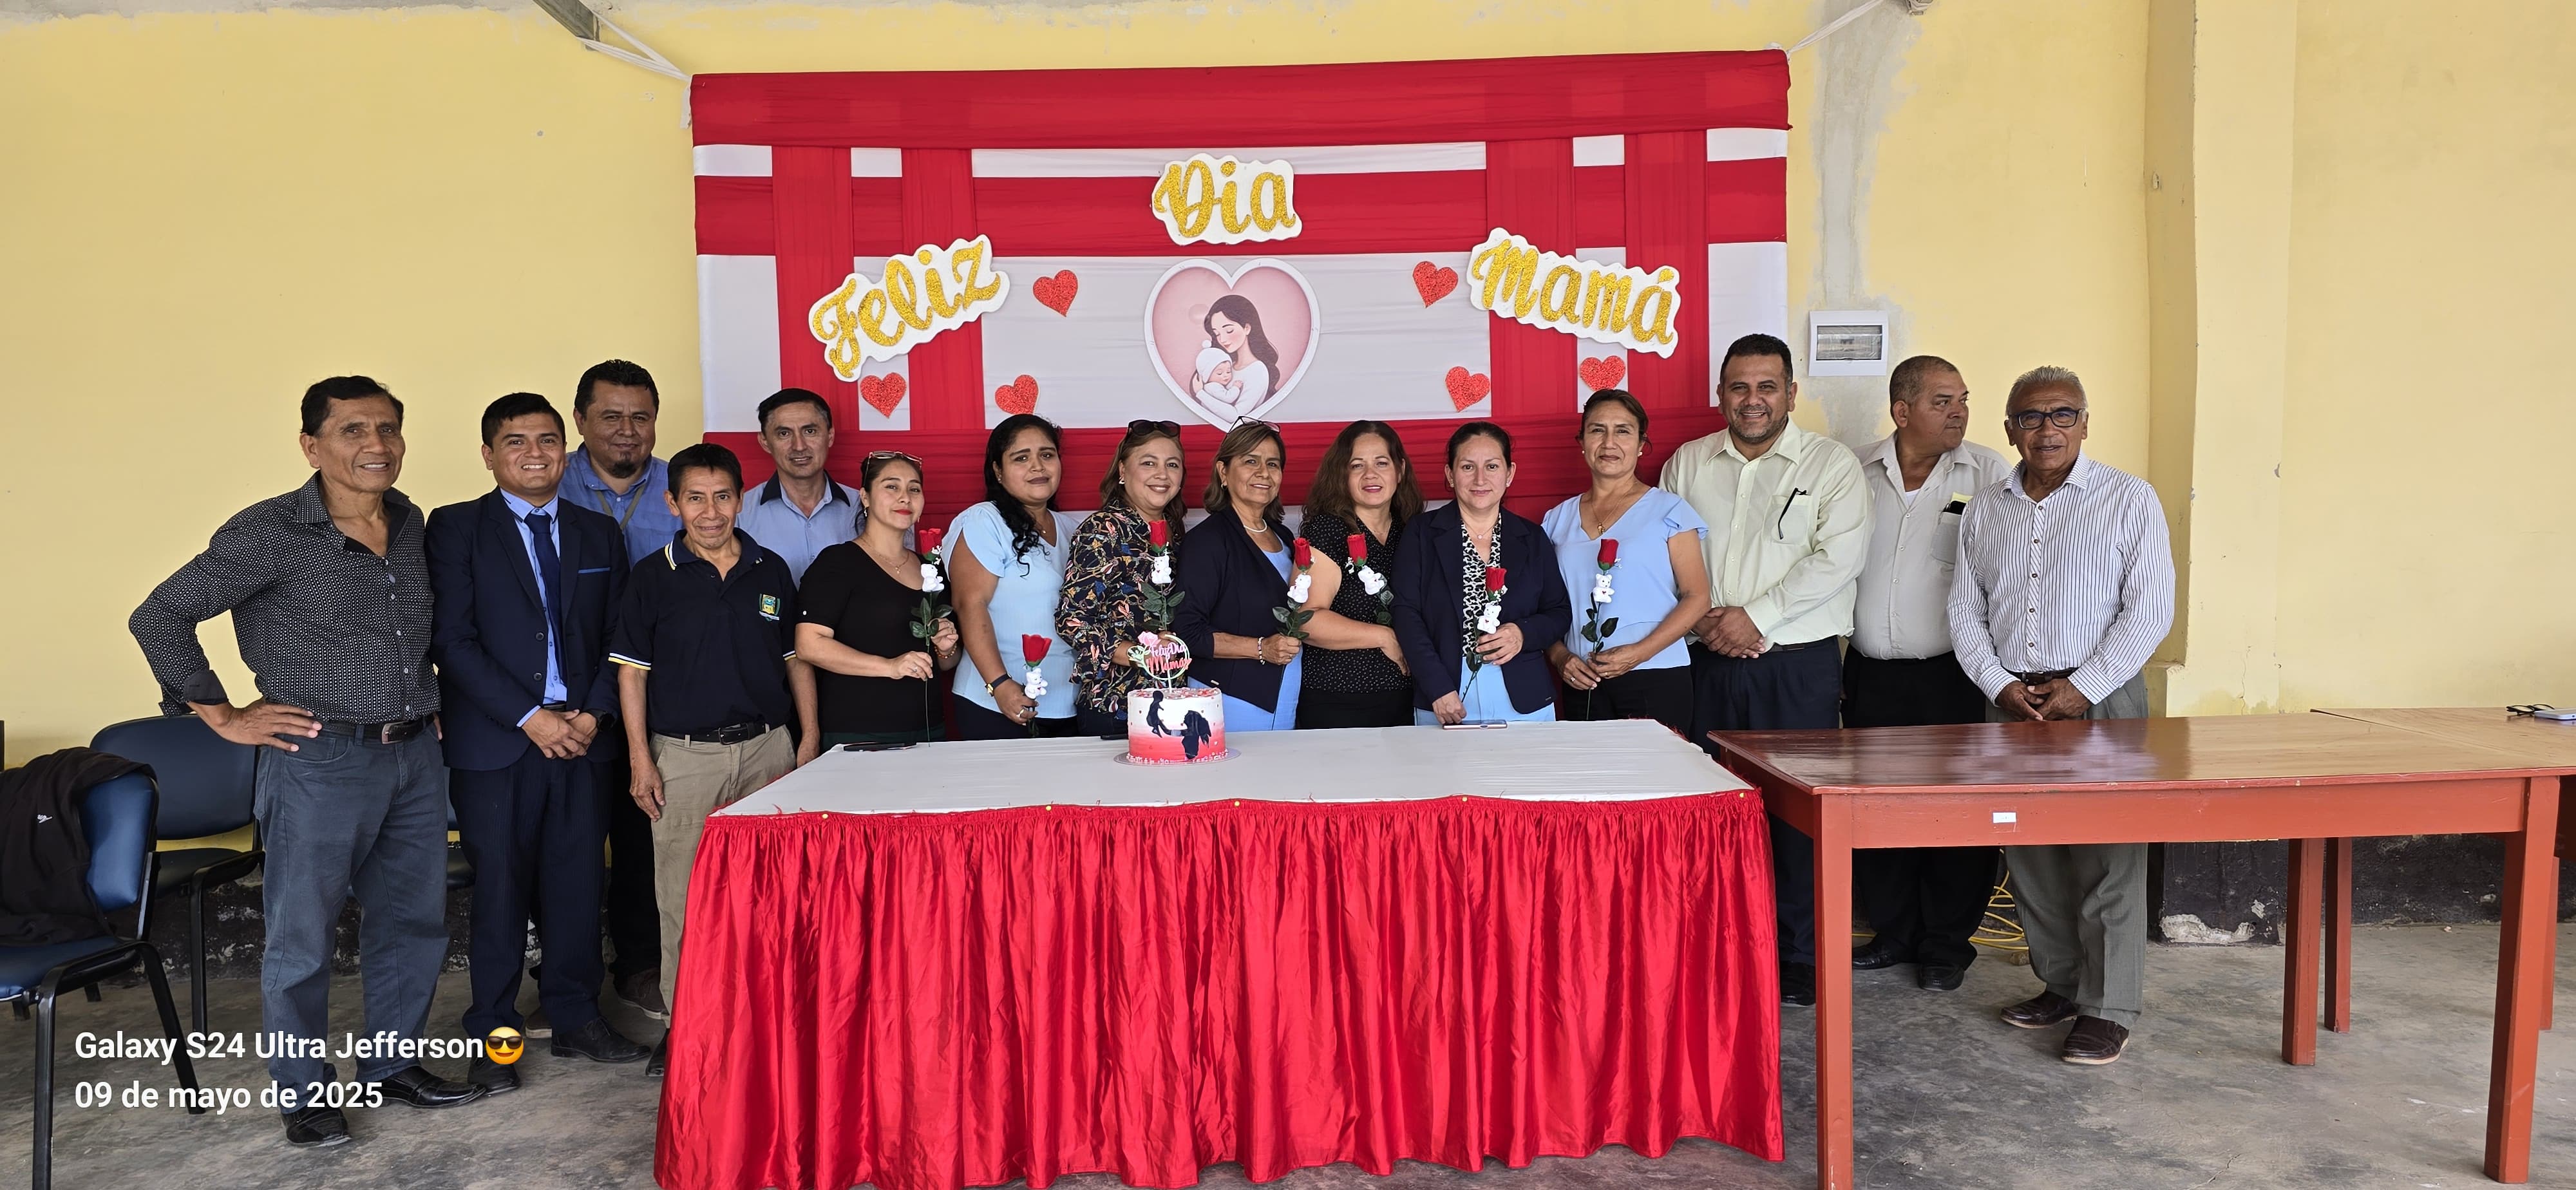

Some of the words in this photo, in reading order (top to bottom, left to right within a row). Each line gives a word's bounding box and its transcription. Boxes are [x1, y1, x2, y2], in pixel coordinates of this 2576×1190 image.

[1153, 160, 1296, 238] Dia
[813, 241, 1001, 377] Feliz
[1472, 239, 1674, 345] Mamá
